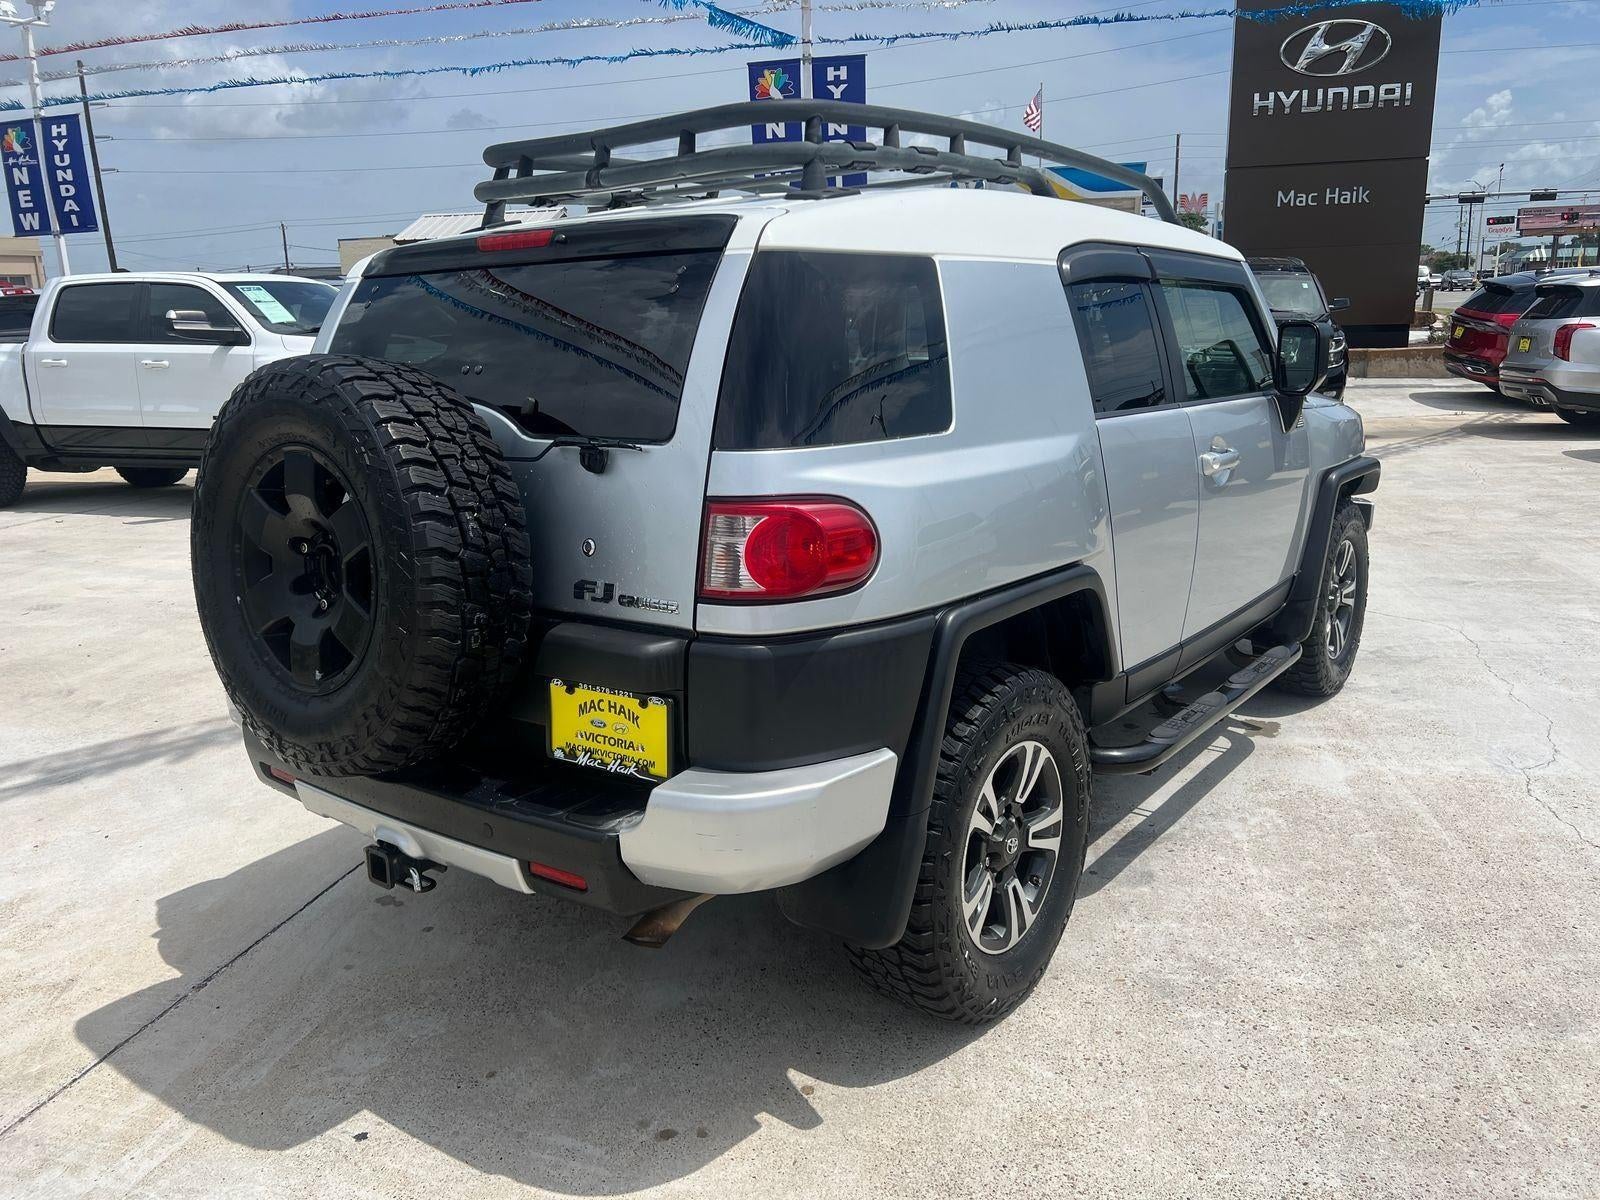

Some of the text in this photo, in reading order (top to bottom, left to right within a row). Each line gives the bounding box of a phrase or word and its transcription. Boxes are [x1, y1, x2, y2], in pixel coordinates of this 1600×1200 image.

[1252, 82, 1413, 116] HYUNDAI
[51, 123, 80, 227] HYUNDAI
[13, 166, 40, 231] NEW
[1276, 186, 1370, 207] Mac Haik
[574, 579, 615, 603] FJ
[578, 699, 640, 729] MAC HAIK
[584, 731, 635, 751] VICTORIA
[576, 751, 640, 776] Mac Haik
